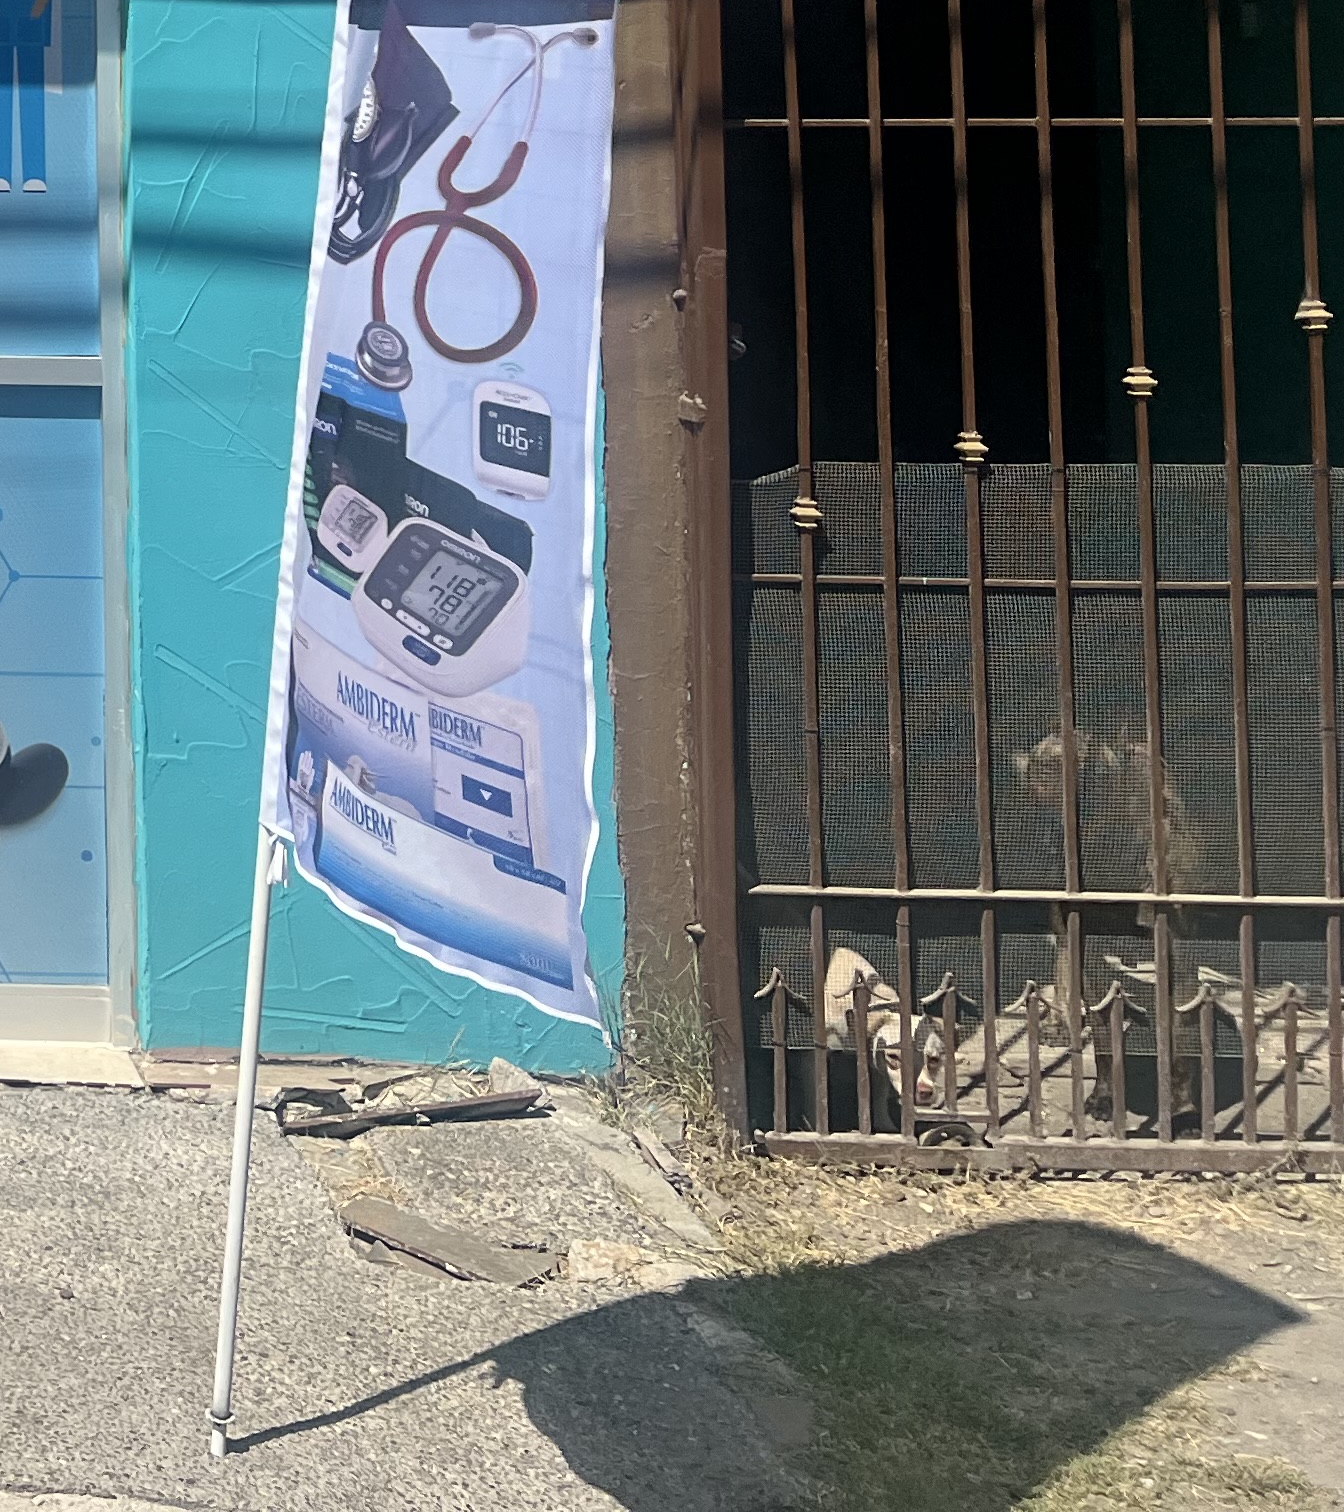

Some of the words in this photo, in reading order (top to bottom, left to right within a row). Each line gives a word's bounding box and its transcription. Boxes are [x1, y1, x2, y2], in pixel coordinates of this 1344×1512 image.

[496, 423, 529, 451] 106
[428, 585, 463, 615] 78
[336, 670, 417, 743] AMBIDERM
[430, 707, 483, 747] BIDERM
[330, 777, 396, 845] AMBIDERM
